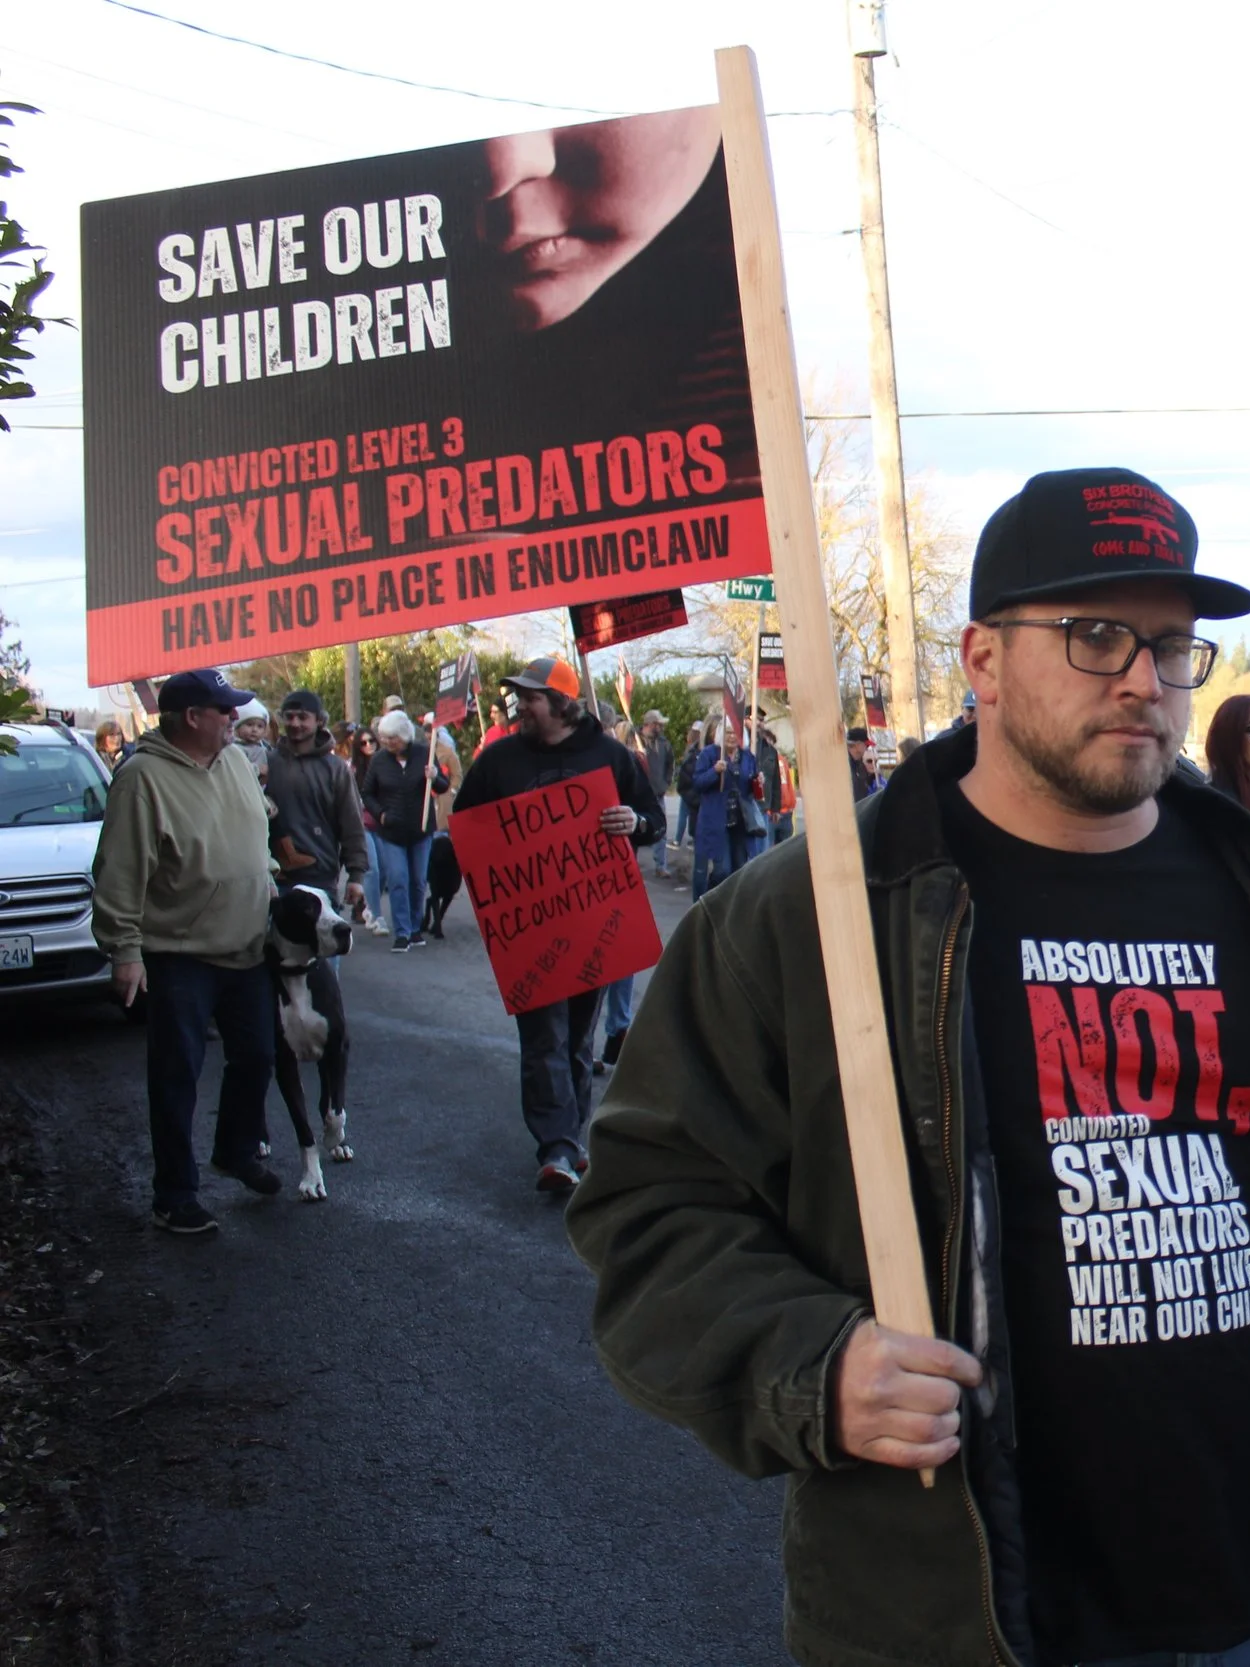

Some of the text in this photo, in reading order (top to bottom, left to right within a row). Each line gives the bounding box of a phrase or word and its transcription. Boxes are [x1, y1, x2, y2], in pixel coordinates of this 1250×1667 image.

[157, 193, 447, 304] SAVE OUR
[159, 278, 452, 394] CHILDREN
[157, 416, 465, 507] CONVICTED LEVEL 3
[155, 422, 728, 584] SEXUAL PREDATORS
[160, 513, 730, 652] HAVE NO PLACE IN ENUMCLAW
[731, 580, 763, 599] Hwy
[496, 783, 590, 846] HOLD
[484, 862, 639, 955] ACCOUNTABLE
[1020, 939, 1216, 985] ABSOLUTELY
[1045, 1114, 1151, 1144] CONVICTED
[1051, 1133, 1241, 1215] SEXUAL
[1061, 1202, 1250, 1263] PREDATORS
[1068, 1263, 1146, 1306] WILL
[1153, 1256, 1207, 1301] NOT
[1070, 1306, 1148, 1346] NEAR
[1156, 1300, 1210, 1342] OUR
